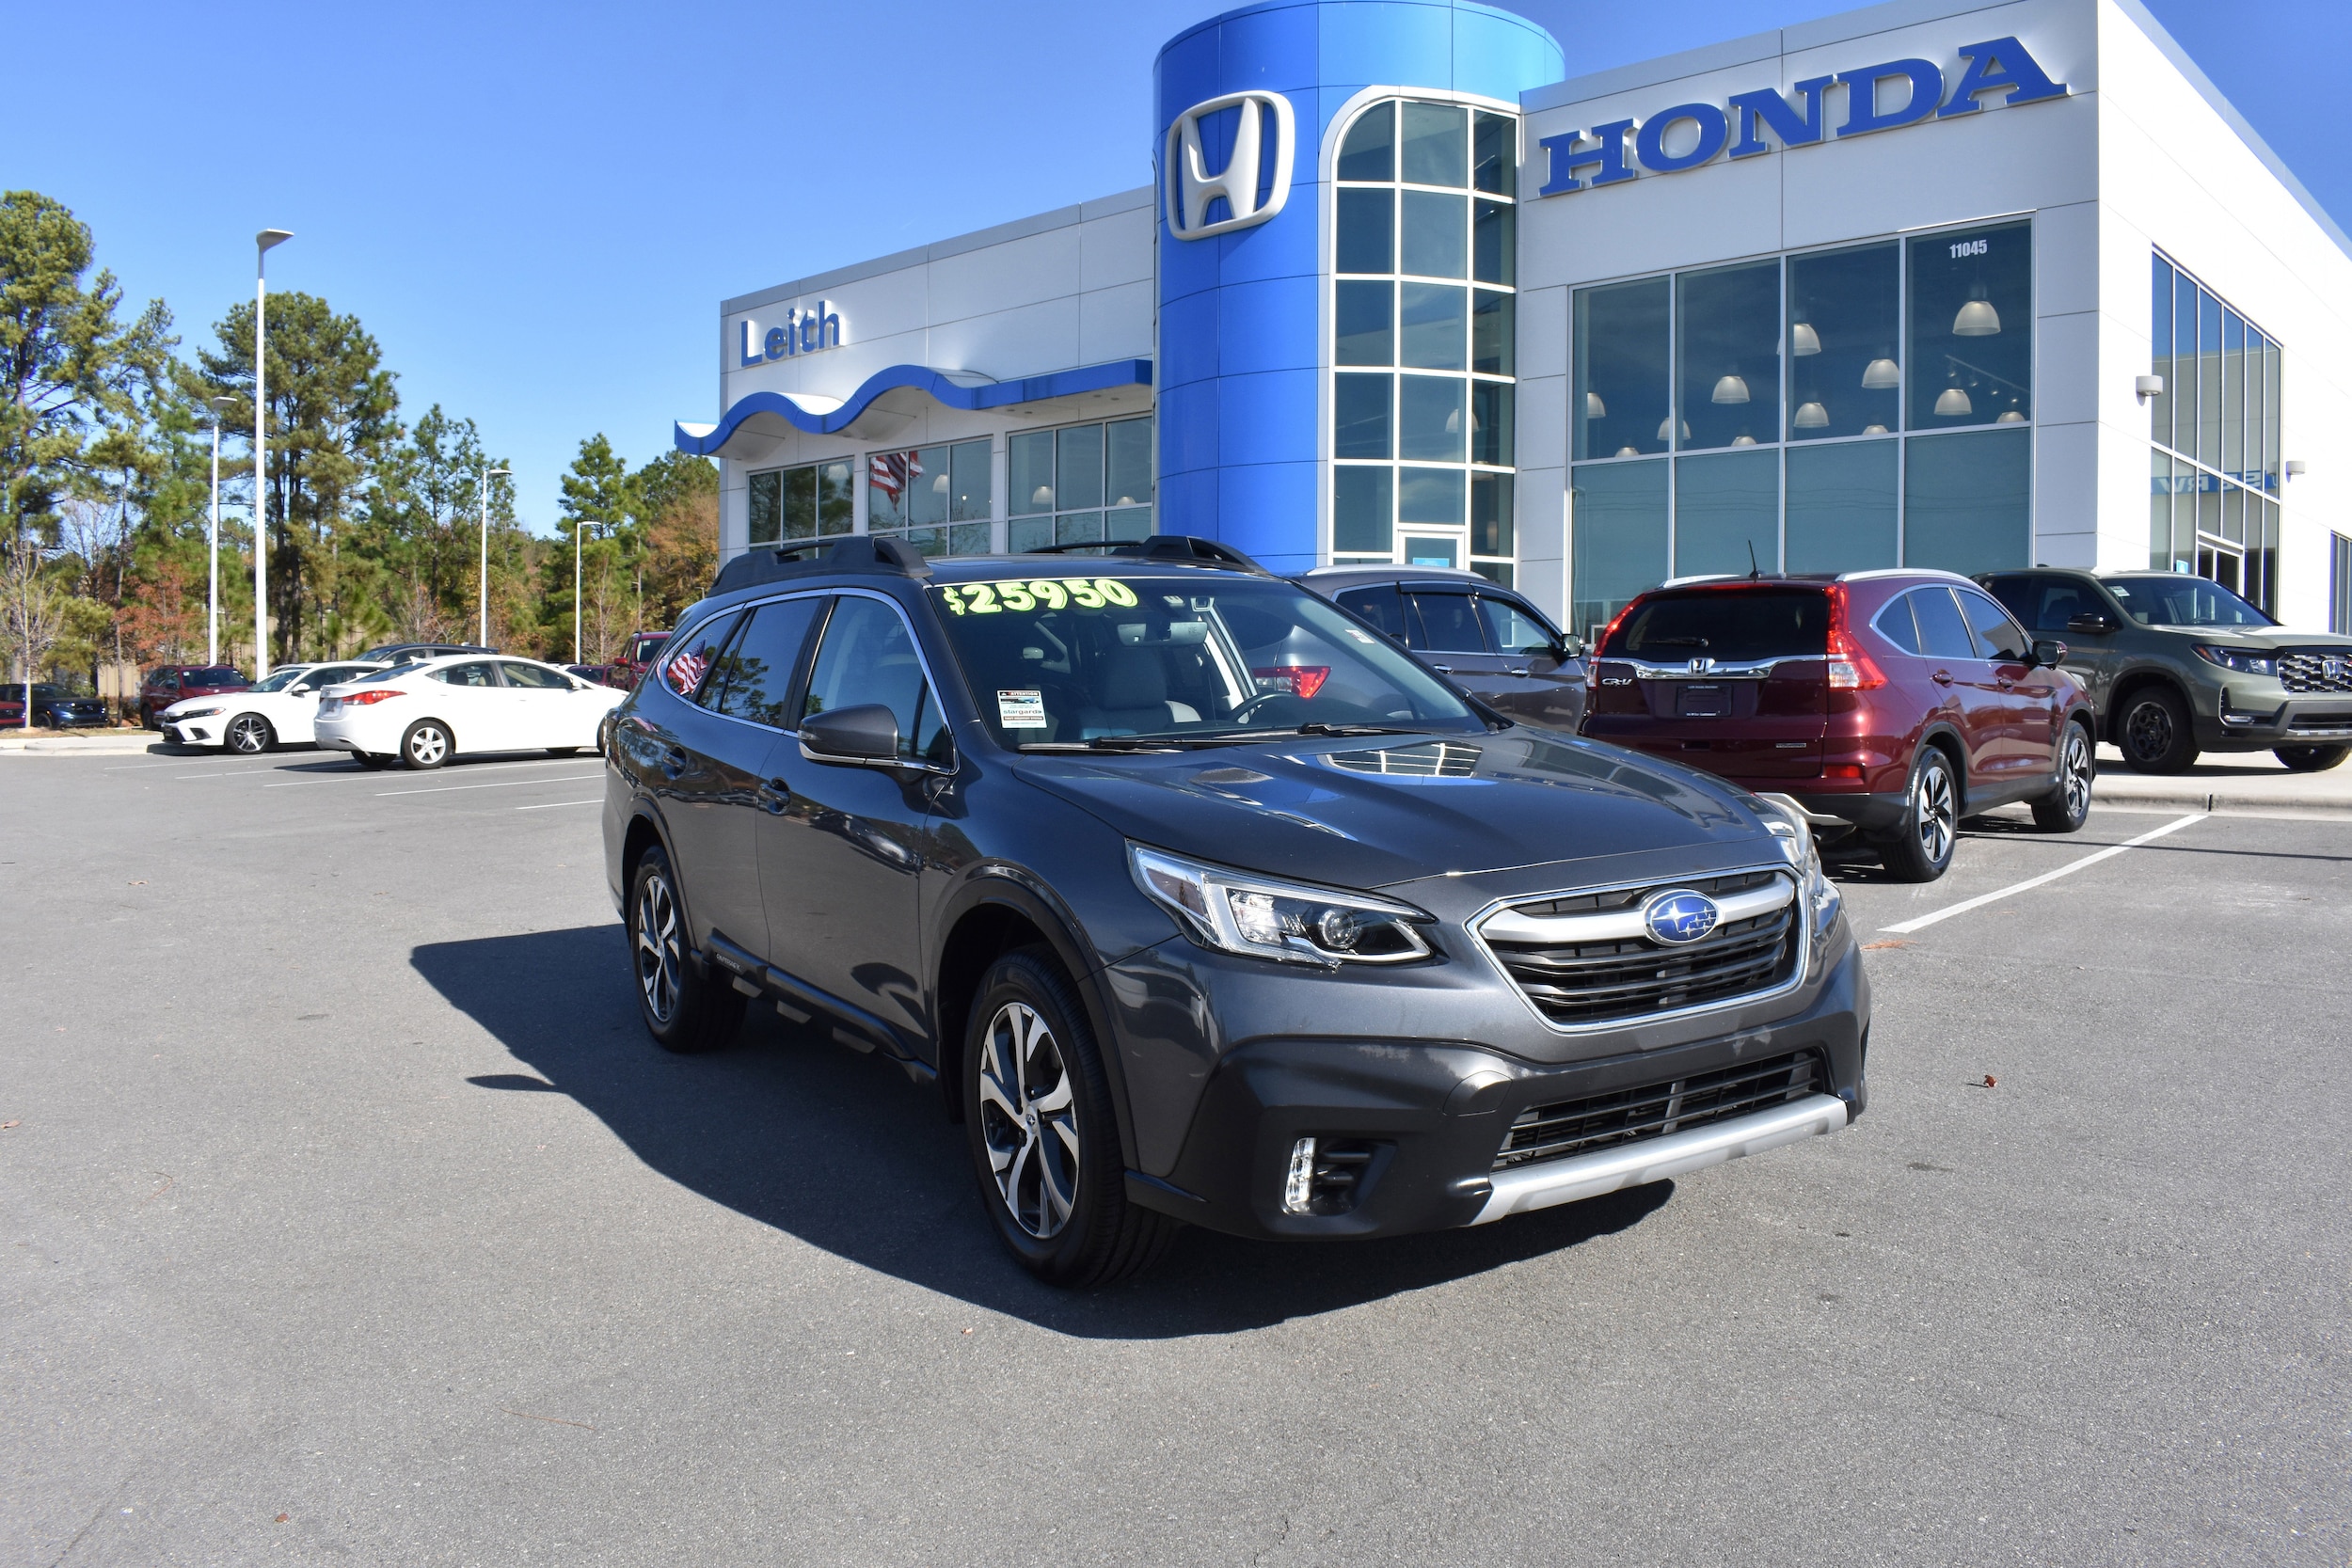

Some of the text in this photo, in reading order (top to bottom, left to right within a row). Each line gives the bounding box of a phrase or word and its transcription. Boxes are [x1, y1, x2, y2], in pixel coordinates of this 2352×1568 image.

[1538, 36, 2069, 198] HONDA
[1948, 239, 1988, 259] 11045
[740, 299, 847, 368] Leith
[943, 578, 1138, 616] $25950
[1601, 677, 1632, 687] CR-V
